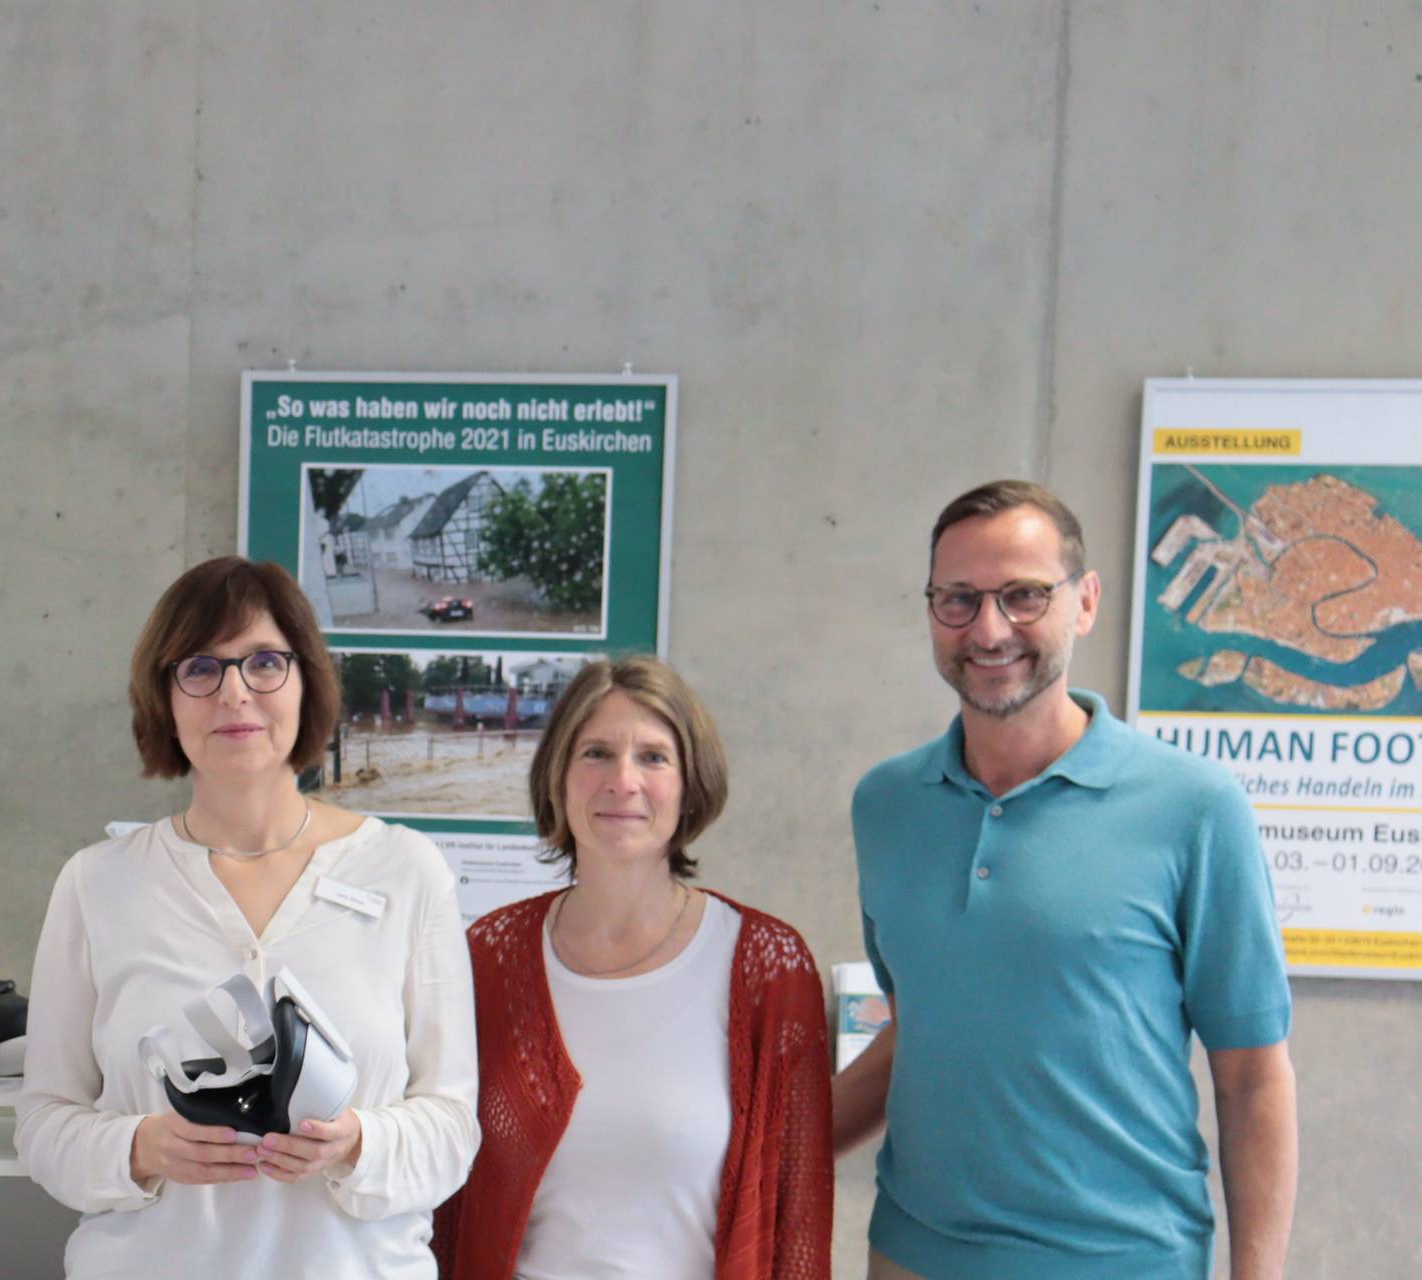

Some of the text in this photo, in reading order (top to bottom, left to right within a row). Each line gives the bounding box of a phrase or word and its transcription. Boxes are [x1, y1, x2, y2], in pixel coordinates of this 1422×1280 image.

[309, 399, 351, 418] was
[355, 396, 418, 419] haben
[424, 397, 458, 420] wir
[462, 398, 511, 420] noch
[517, 398, 568, 421] nicht
[267, 425, 652, 453] Die Flutkatastrophe 2021 in Euskirchen
[1165, 434, 1291, 449] AUSSTELLUNG
[1330, 731, 1422, 765] FOO
[1296, 775, 1382, 799] Handeln
[1389, 778, 1415, 799] im
[1332, 852, 1422, 874] 01.09.2
